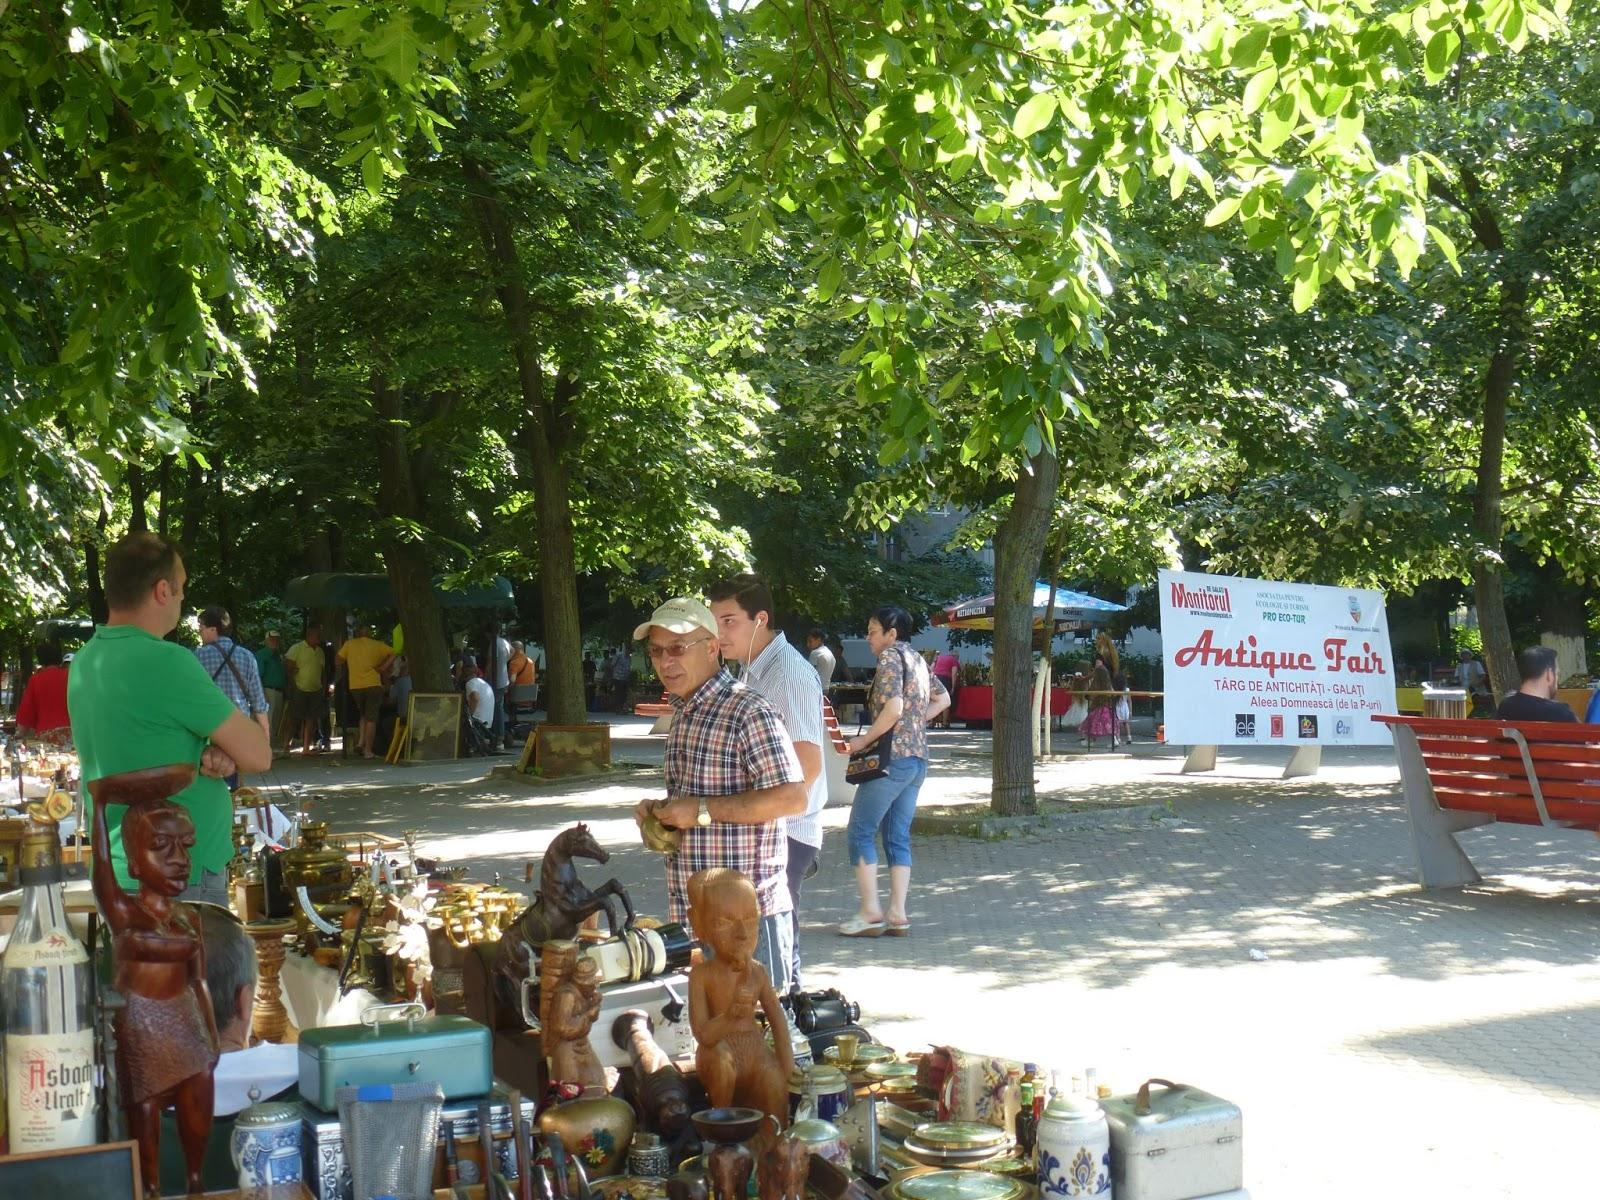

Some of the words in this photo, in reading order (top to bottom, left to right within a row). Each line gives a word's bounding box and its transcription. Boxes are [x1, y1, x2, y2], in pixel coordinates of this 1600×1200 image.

[1171, 582, 1231, 612] Monitorul
[1262, 611, 1277, 622] PRO
[1279, 612, 1306, 624] ECO-TUR
[1174, 629, 1316, 679] Antique
[1323, 638, 1386, 674] Fair
[1215, 677, 1246, 692] TÂRG
[1248, 680, 1263, 692] DE
[1250, 696, 1278, 708] Aleea
[1336, 698, 1349, 712] (de
[1351, 699, 1359, 710] la
[1360, 699, 1382, 713] P-uri)
[28, 1057, 92, 1092] Asbach
[44, 1088, 85, 1111] Uralt
